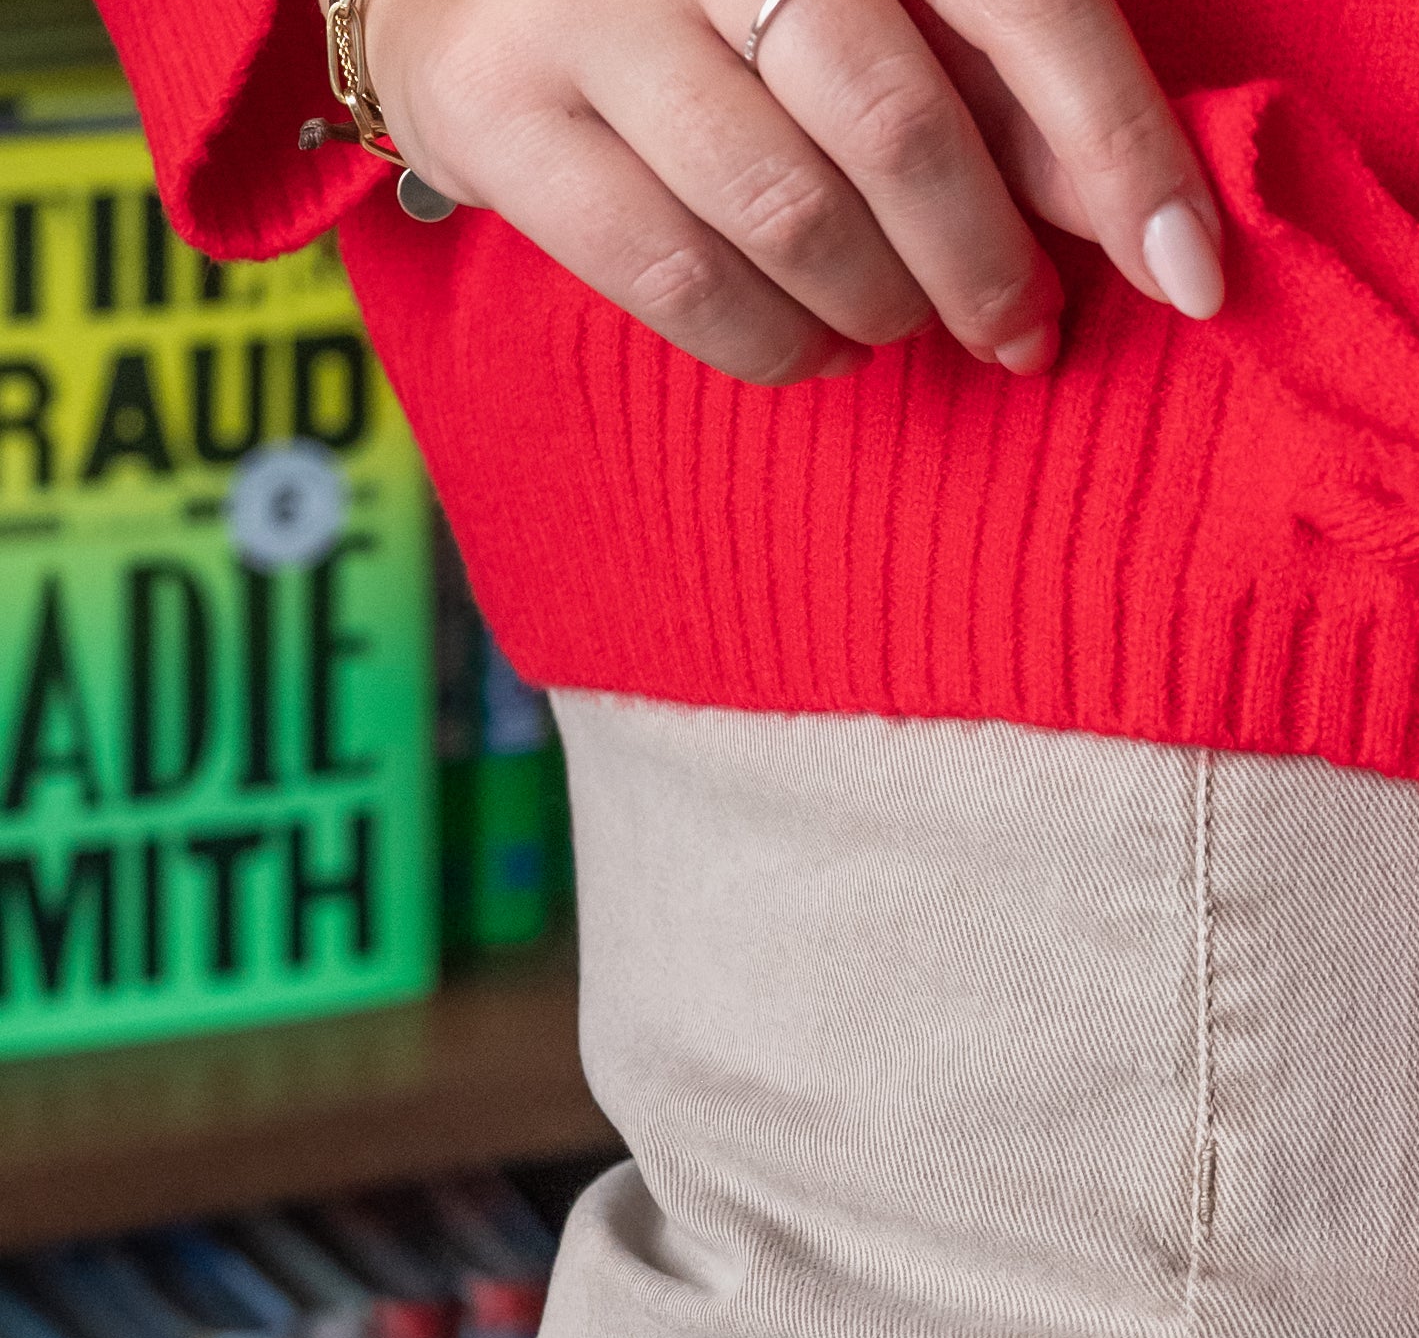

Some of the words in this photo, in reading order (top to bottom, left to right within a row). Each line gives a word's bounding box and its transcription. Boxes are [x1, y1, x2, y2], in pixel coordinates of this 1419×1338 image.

[0, 333, 368, 489] RAUD
[2, 531, 380, 811] ADIE
[0, 809, 376, 1003] MITH
